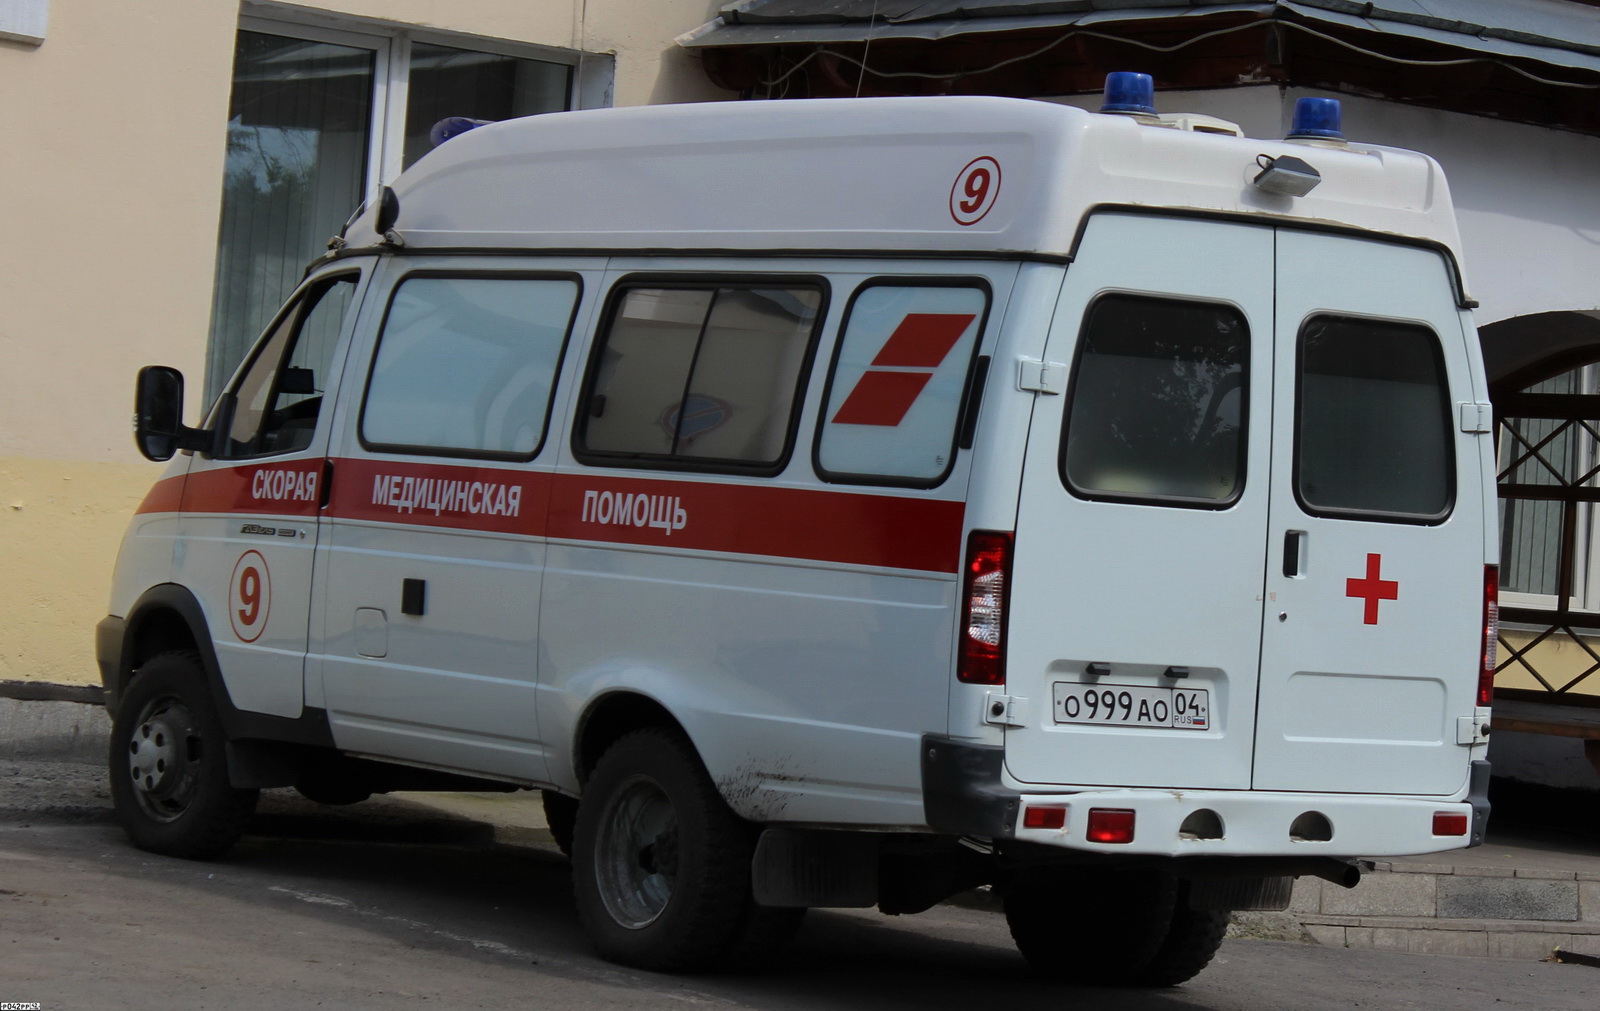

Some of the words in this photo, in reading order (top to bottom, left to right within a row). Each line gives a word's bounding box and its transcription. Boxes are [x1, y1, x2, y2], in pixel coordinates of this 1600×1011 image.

[959, 167, 991, 214] 9
[252, 469, 318, 501] СКОРАЯ
[371, 474, 522, 517] МЕДИЦИНСКАЯ
[581, 489, 688, 536] ПОМОЩЬ
[238, 566, 261, 627] 9
[1174, 715, 1193, 725] RUS
[1175, 692, 1200, 716] 04
